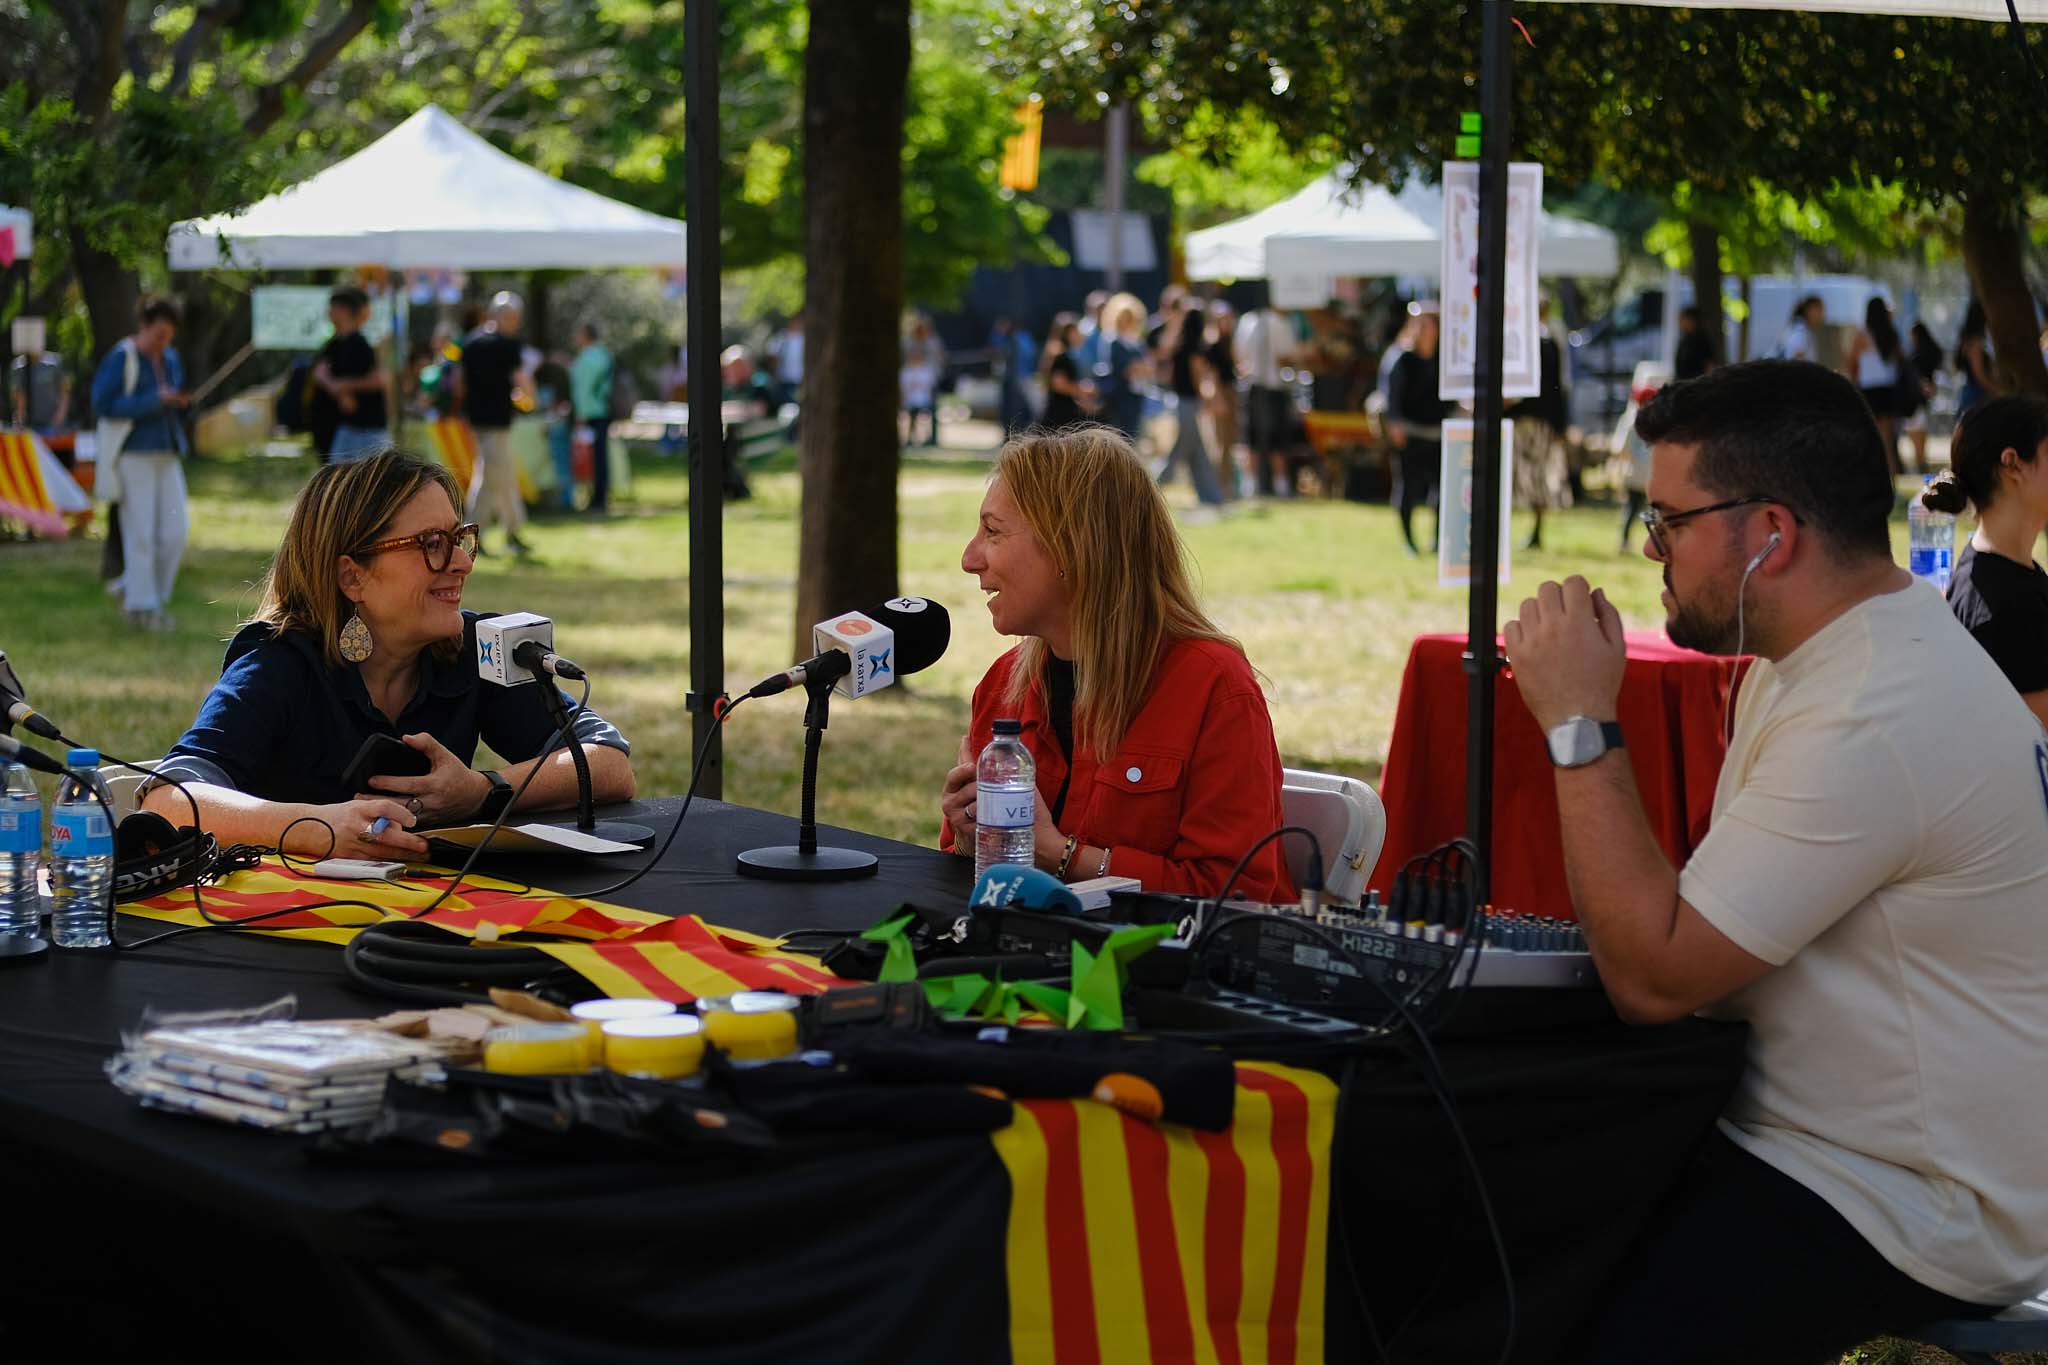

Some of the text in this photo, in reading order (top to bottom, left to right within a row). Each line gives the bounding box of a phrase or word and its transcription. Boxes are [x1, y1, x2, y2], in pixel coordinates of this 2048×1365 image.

[496, 668, 502, 679] la
[857, 648, 866, 693] la xarxa
